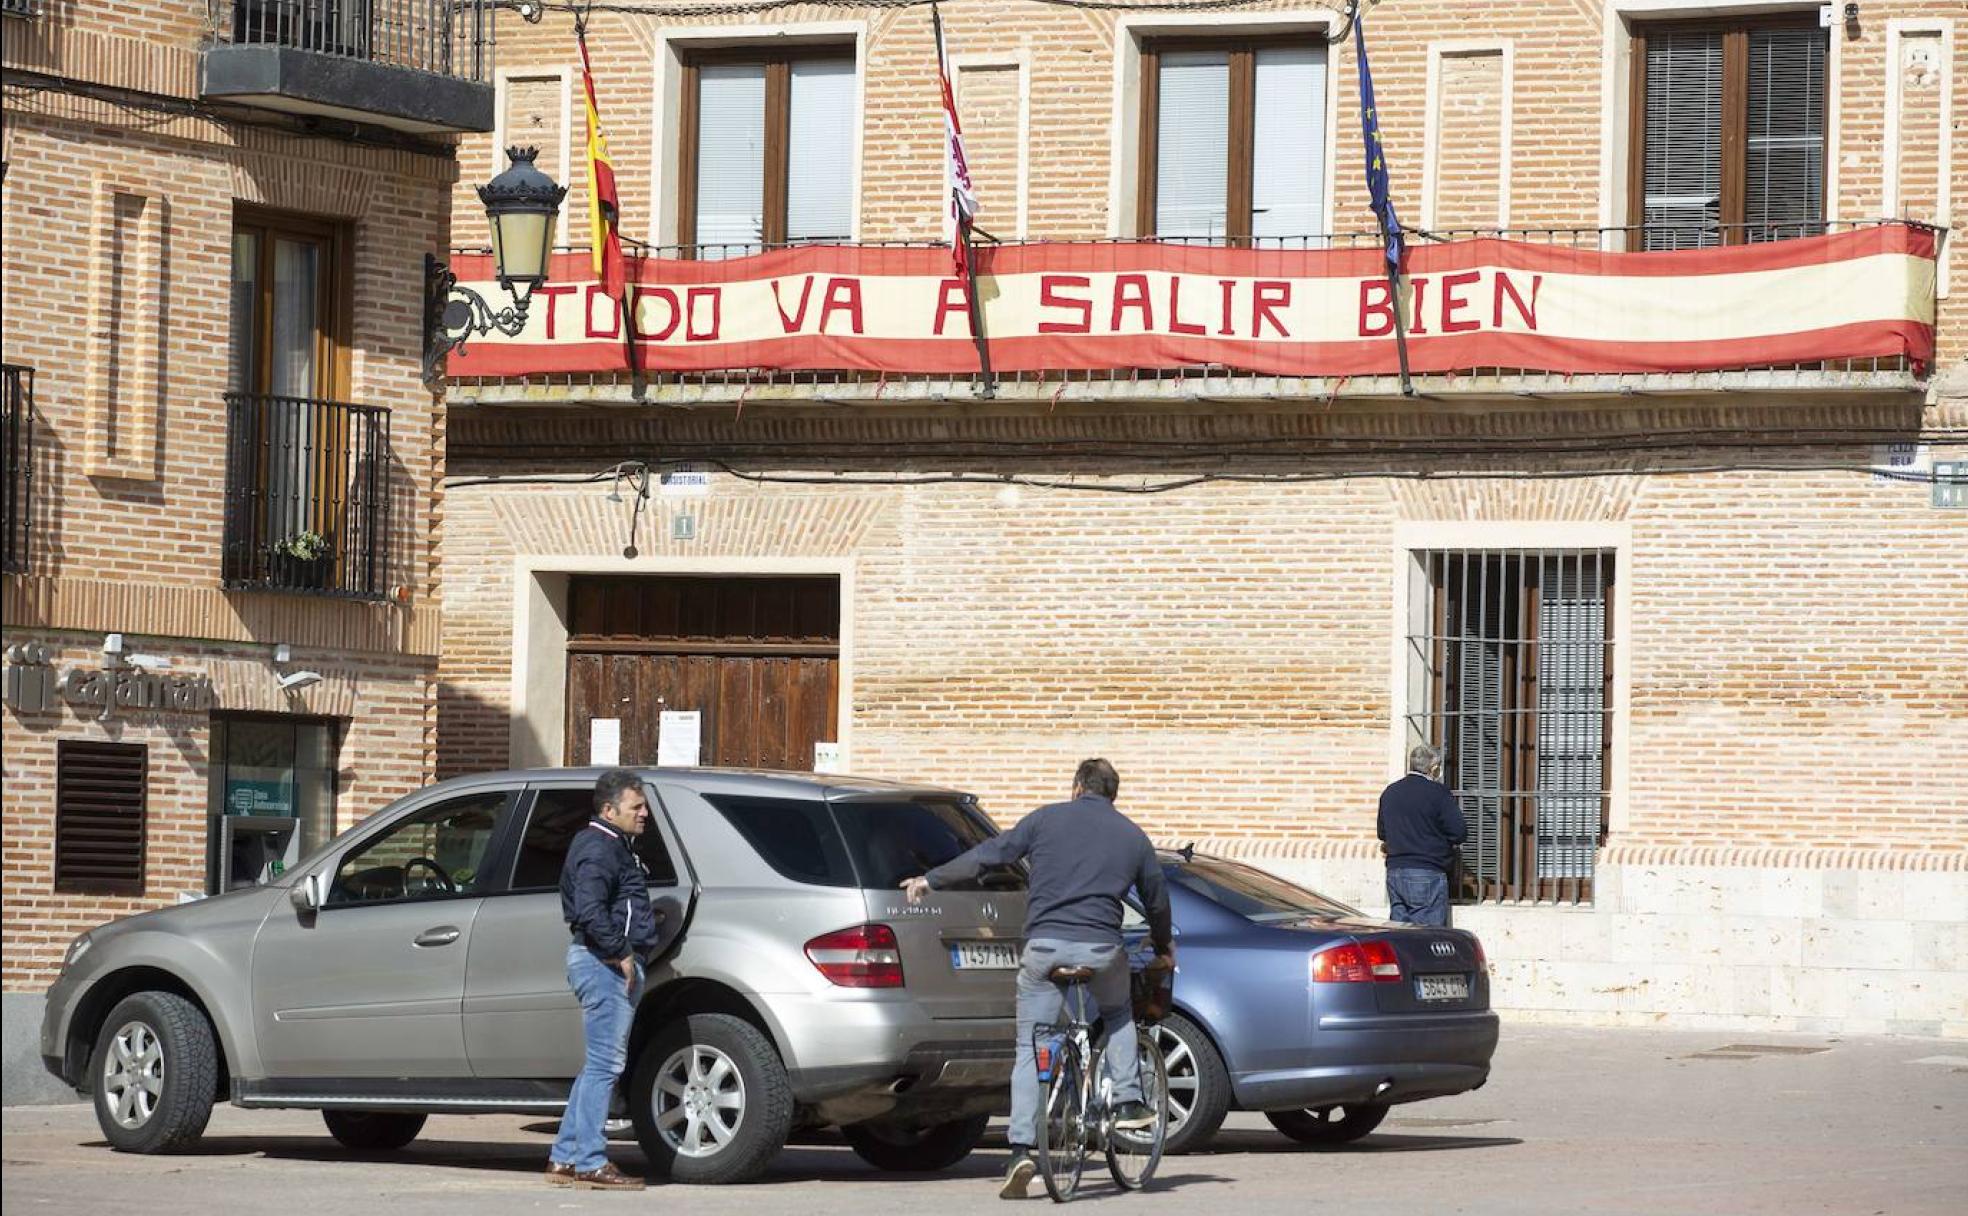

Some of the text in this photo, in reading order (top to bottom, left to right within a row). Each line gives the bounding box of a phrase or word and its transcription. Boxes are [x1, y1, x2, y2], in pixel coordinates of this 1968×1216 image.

[531, 271, 1542, 342] TODO VA A SALIR BIEN
